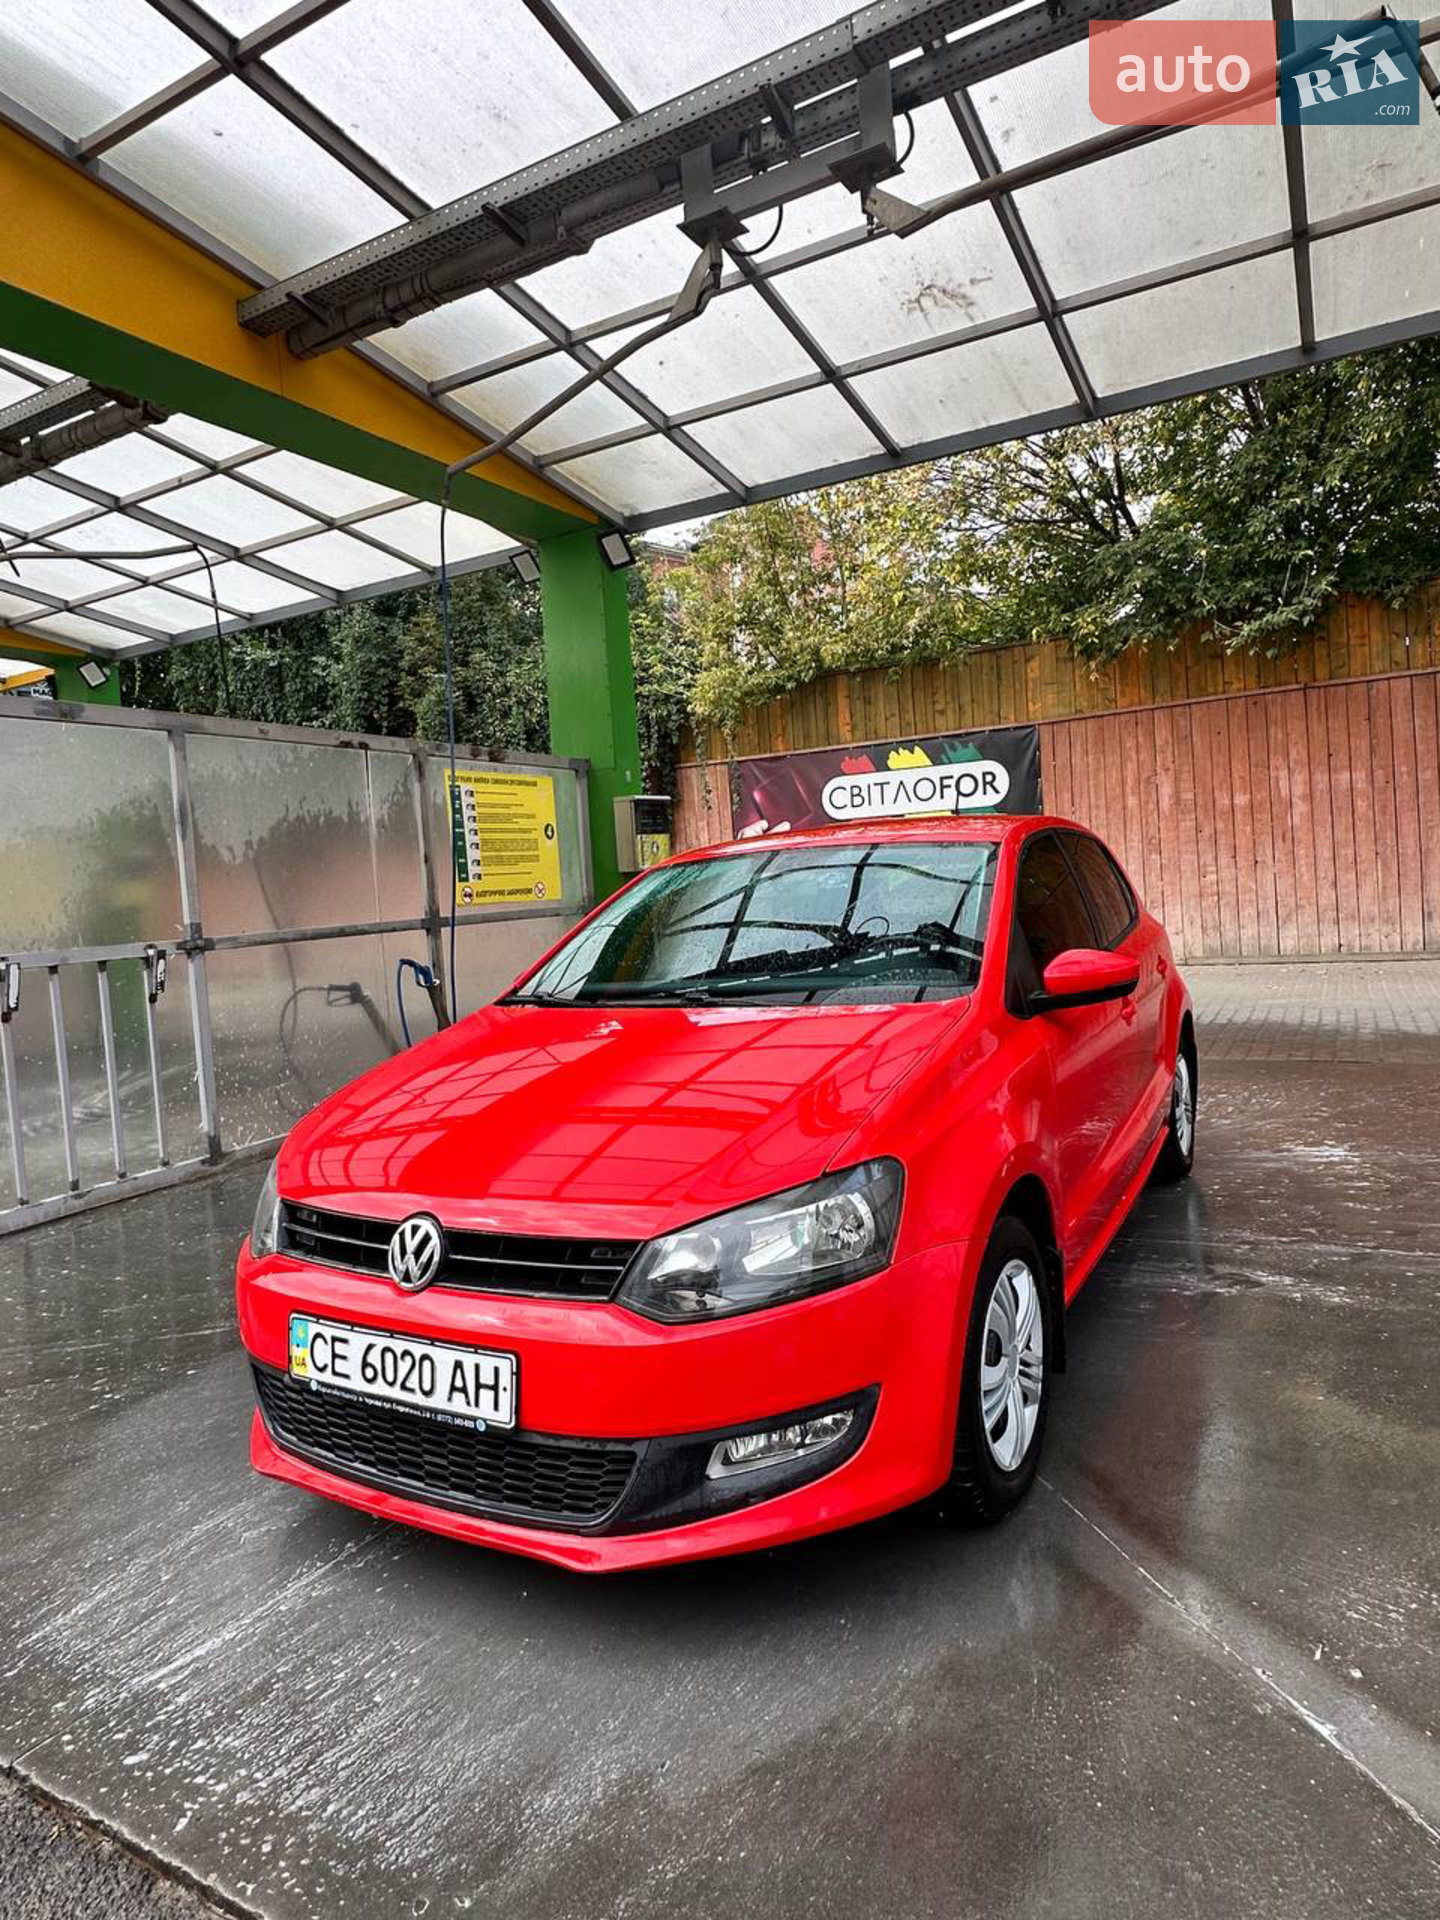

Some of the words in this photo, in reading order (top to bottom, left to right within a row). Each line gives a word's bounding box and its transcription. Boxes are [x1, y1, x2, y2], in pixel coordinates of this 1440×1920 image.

[294, 1355, 307, 1369] UA
[309, 1332, 351, 1380] CE
[361, 1343, 436, 1399] 6020
[447, 1359, 501, 1412] AH
